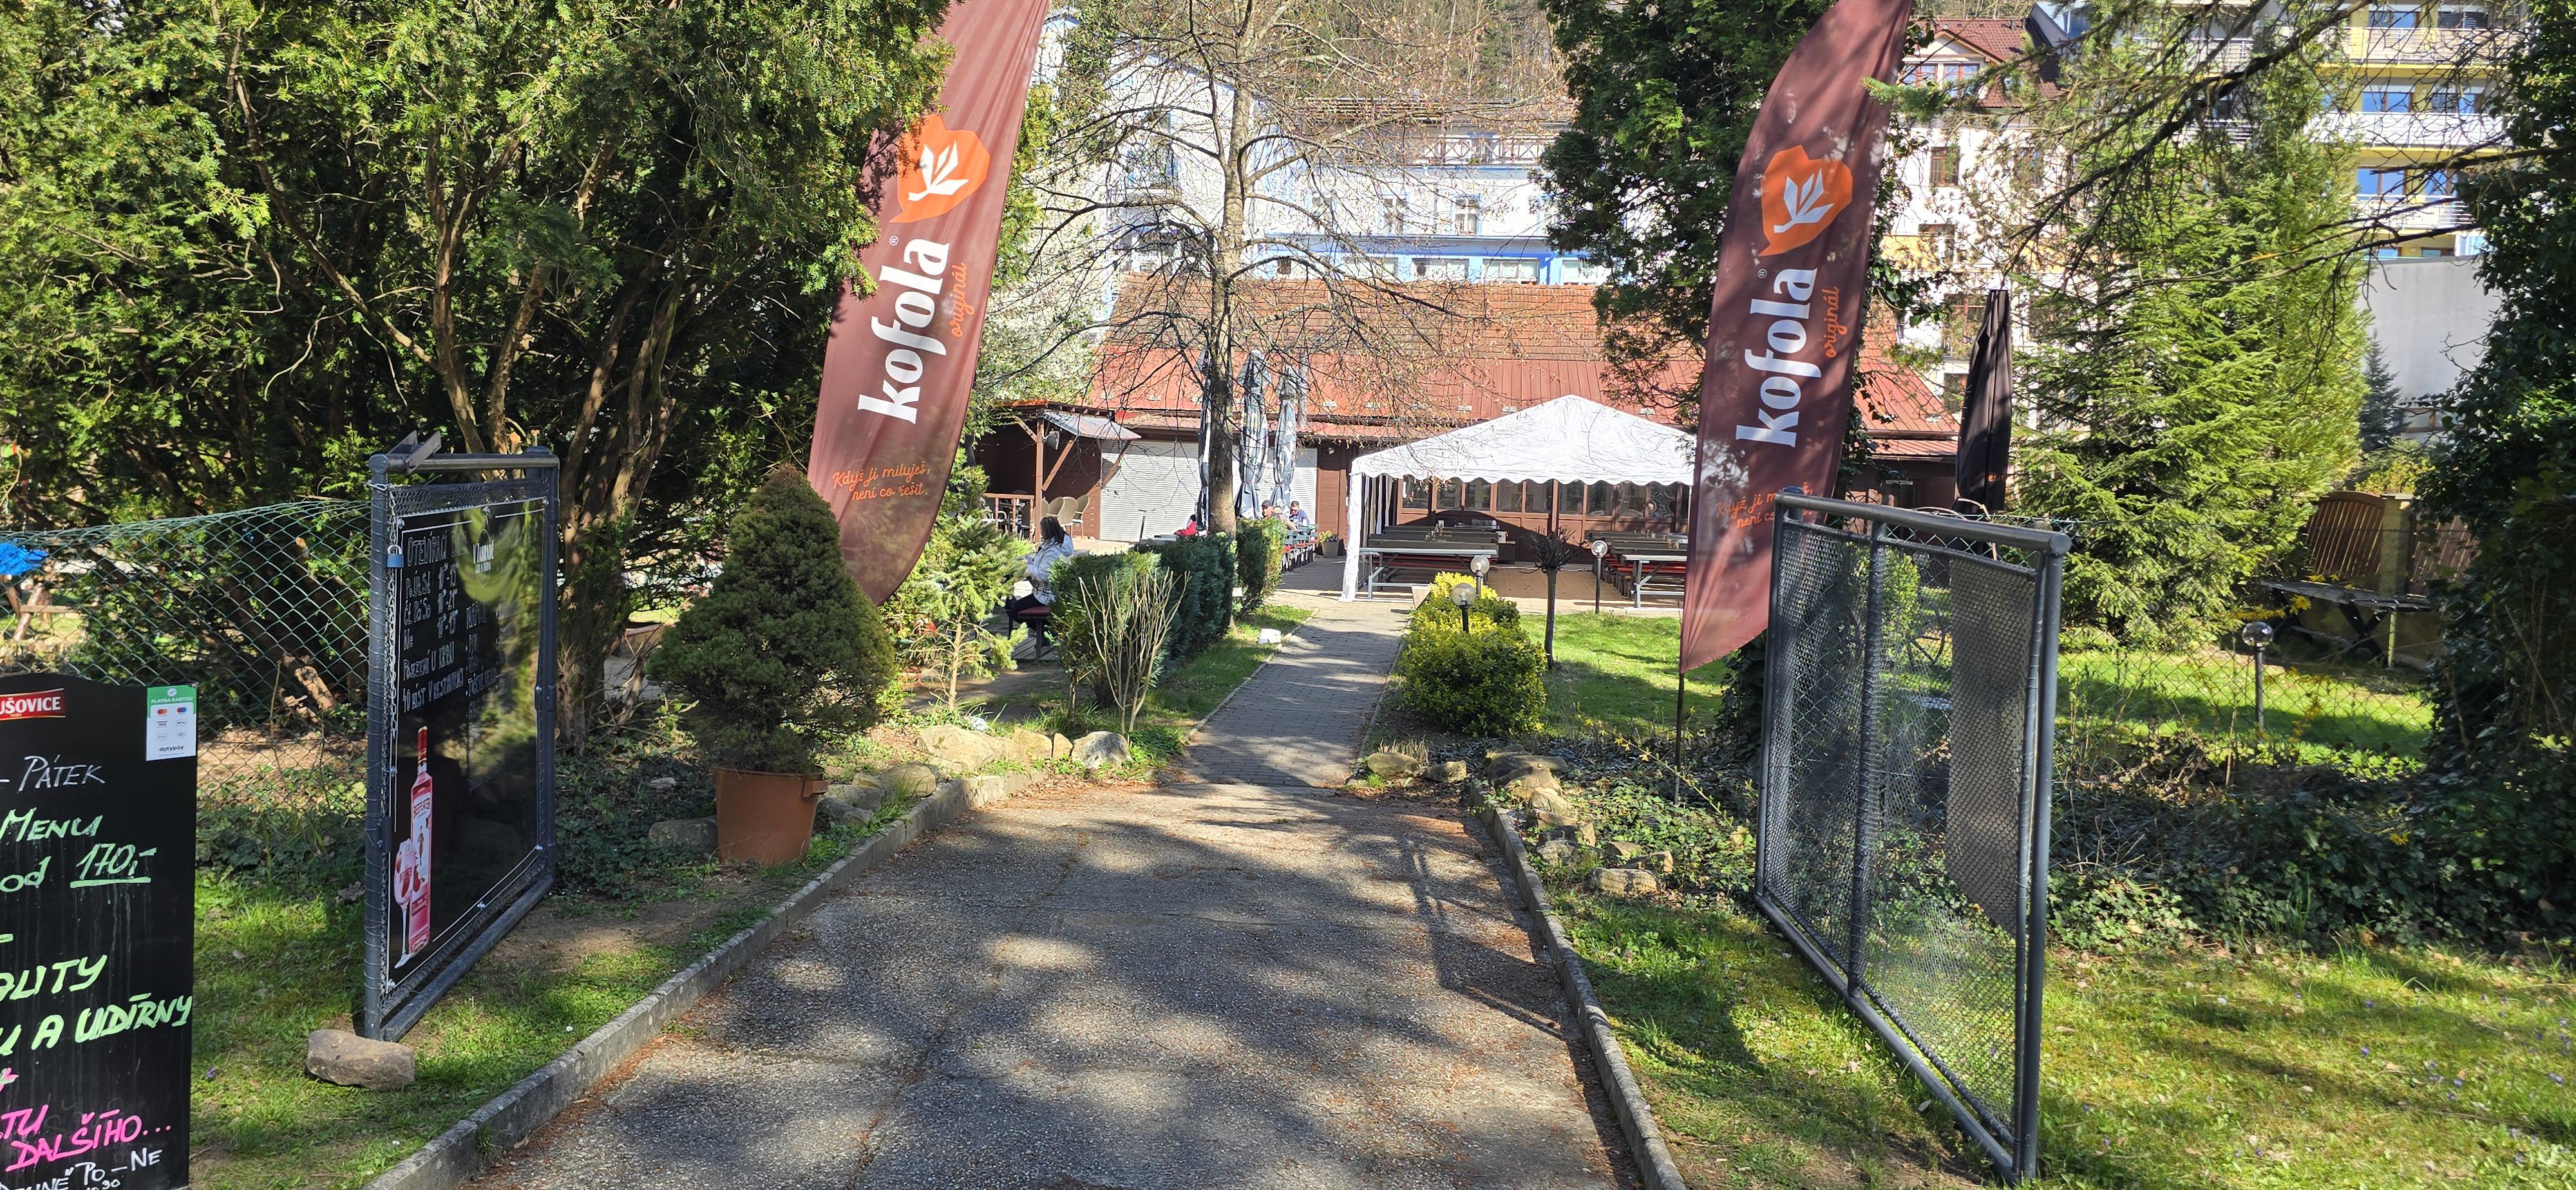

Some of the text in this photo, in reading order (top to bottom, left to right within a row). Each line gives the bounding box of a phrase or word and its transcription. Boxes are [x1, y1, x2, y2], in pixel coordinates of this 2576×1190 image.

[949, 262, 975, 337] originál
[857, 238, 950, 424] kofola
[1822, 286, 1847, 358] originál
[1736, 267, 1821, 448] kofola
[832, 459, 931, 491] Když ji miluješ,
[851, 487, 876, 500] není
[880, 487, 896, 497] co
[1716, 494, 1763, 519] Když ji
[1737, 512, 1763, 528] není
[18, 754, 106, 792] PÁTEK
[0, 856, 52, 892] od
[31, 1014, 64, 1050] A
[75, 1162, 106, 1185] PO
[131, 1148, 162, 1171] NE
